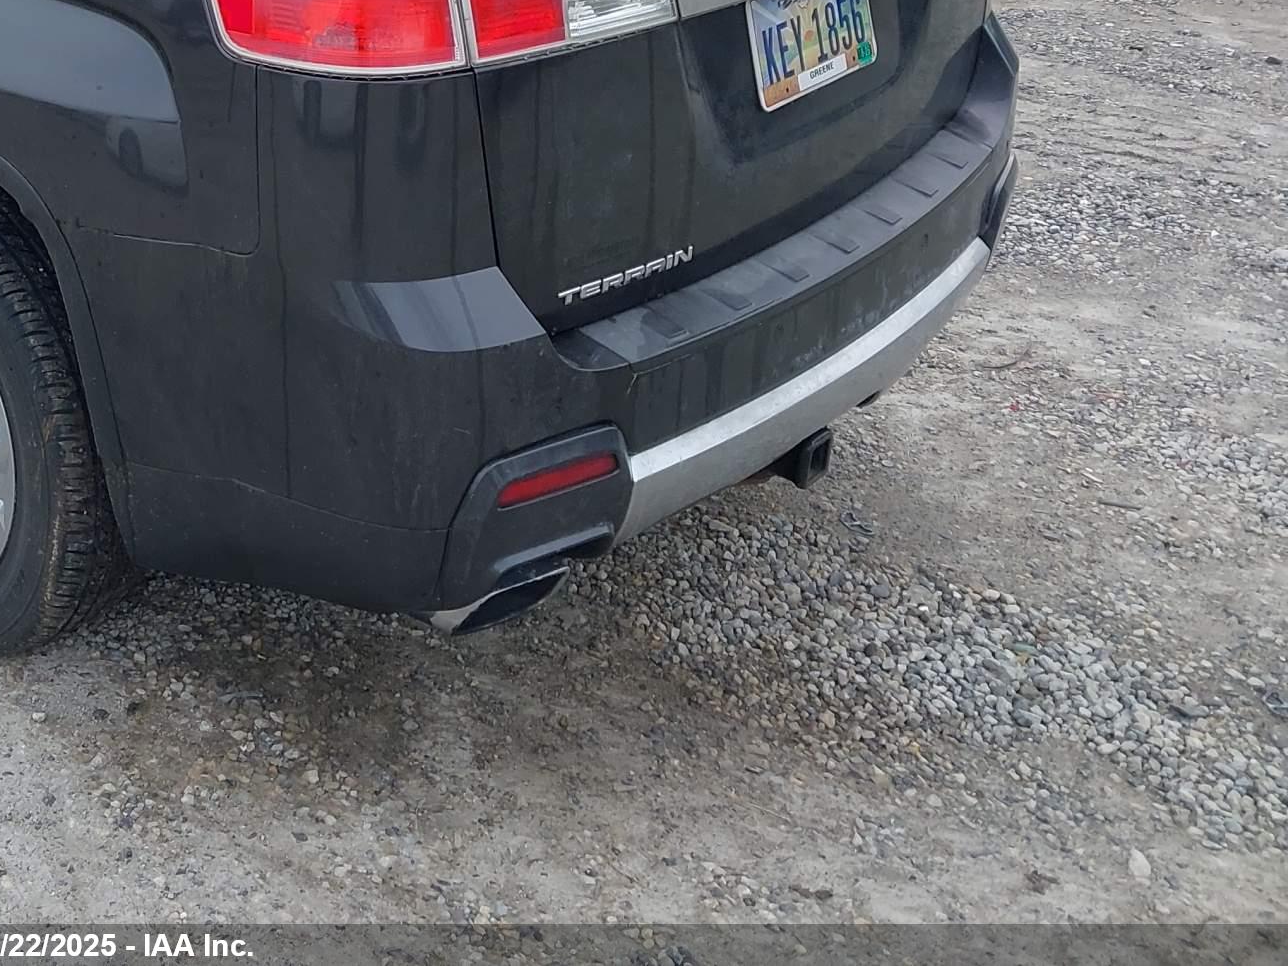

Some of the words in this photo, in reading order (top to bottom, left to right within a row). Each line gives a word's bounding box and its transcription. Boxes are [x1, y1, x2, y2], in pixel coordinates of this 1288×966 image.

[762, 15, 806, 85] KEY
[809, 61, 835, 80] GREENE
[558, 245, 694, 306] TERRAIN
